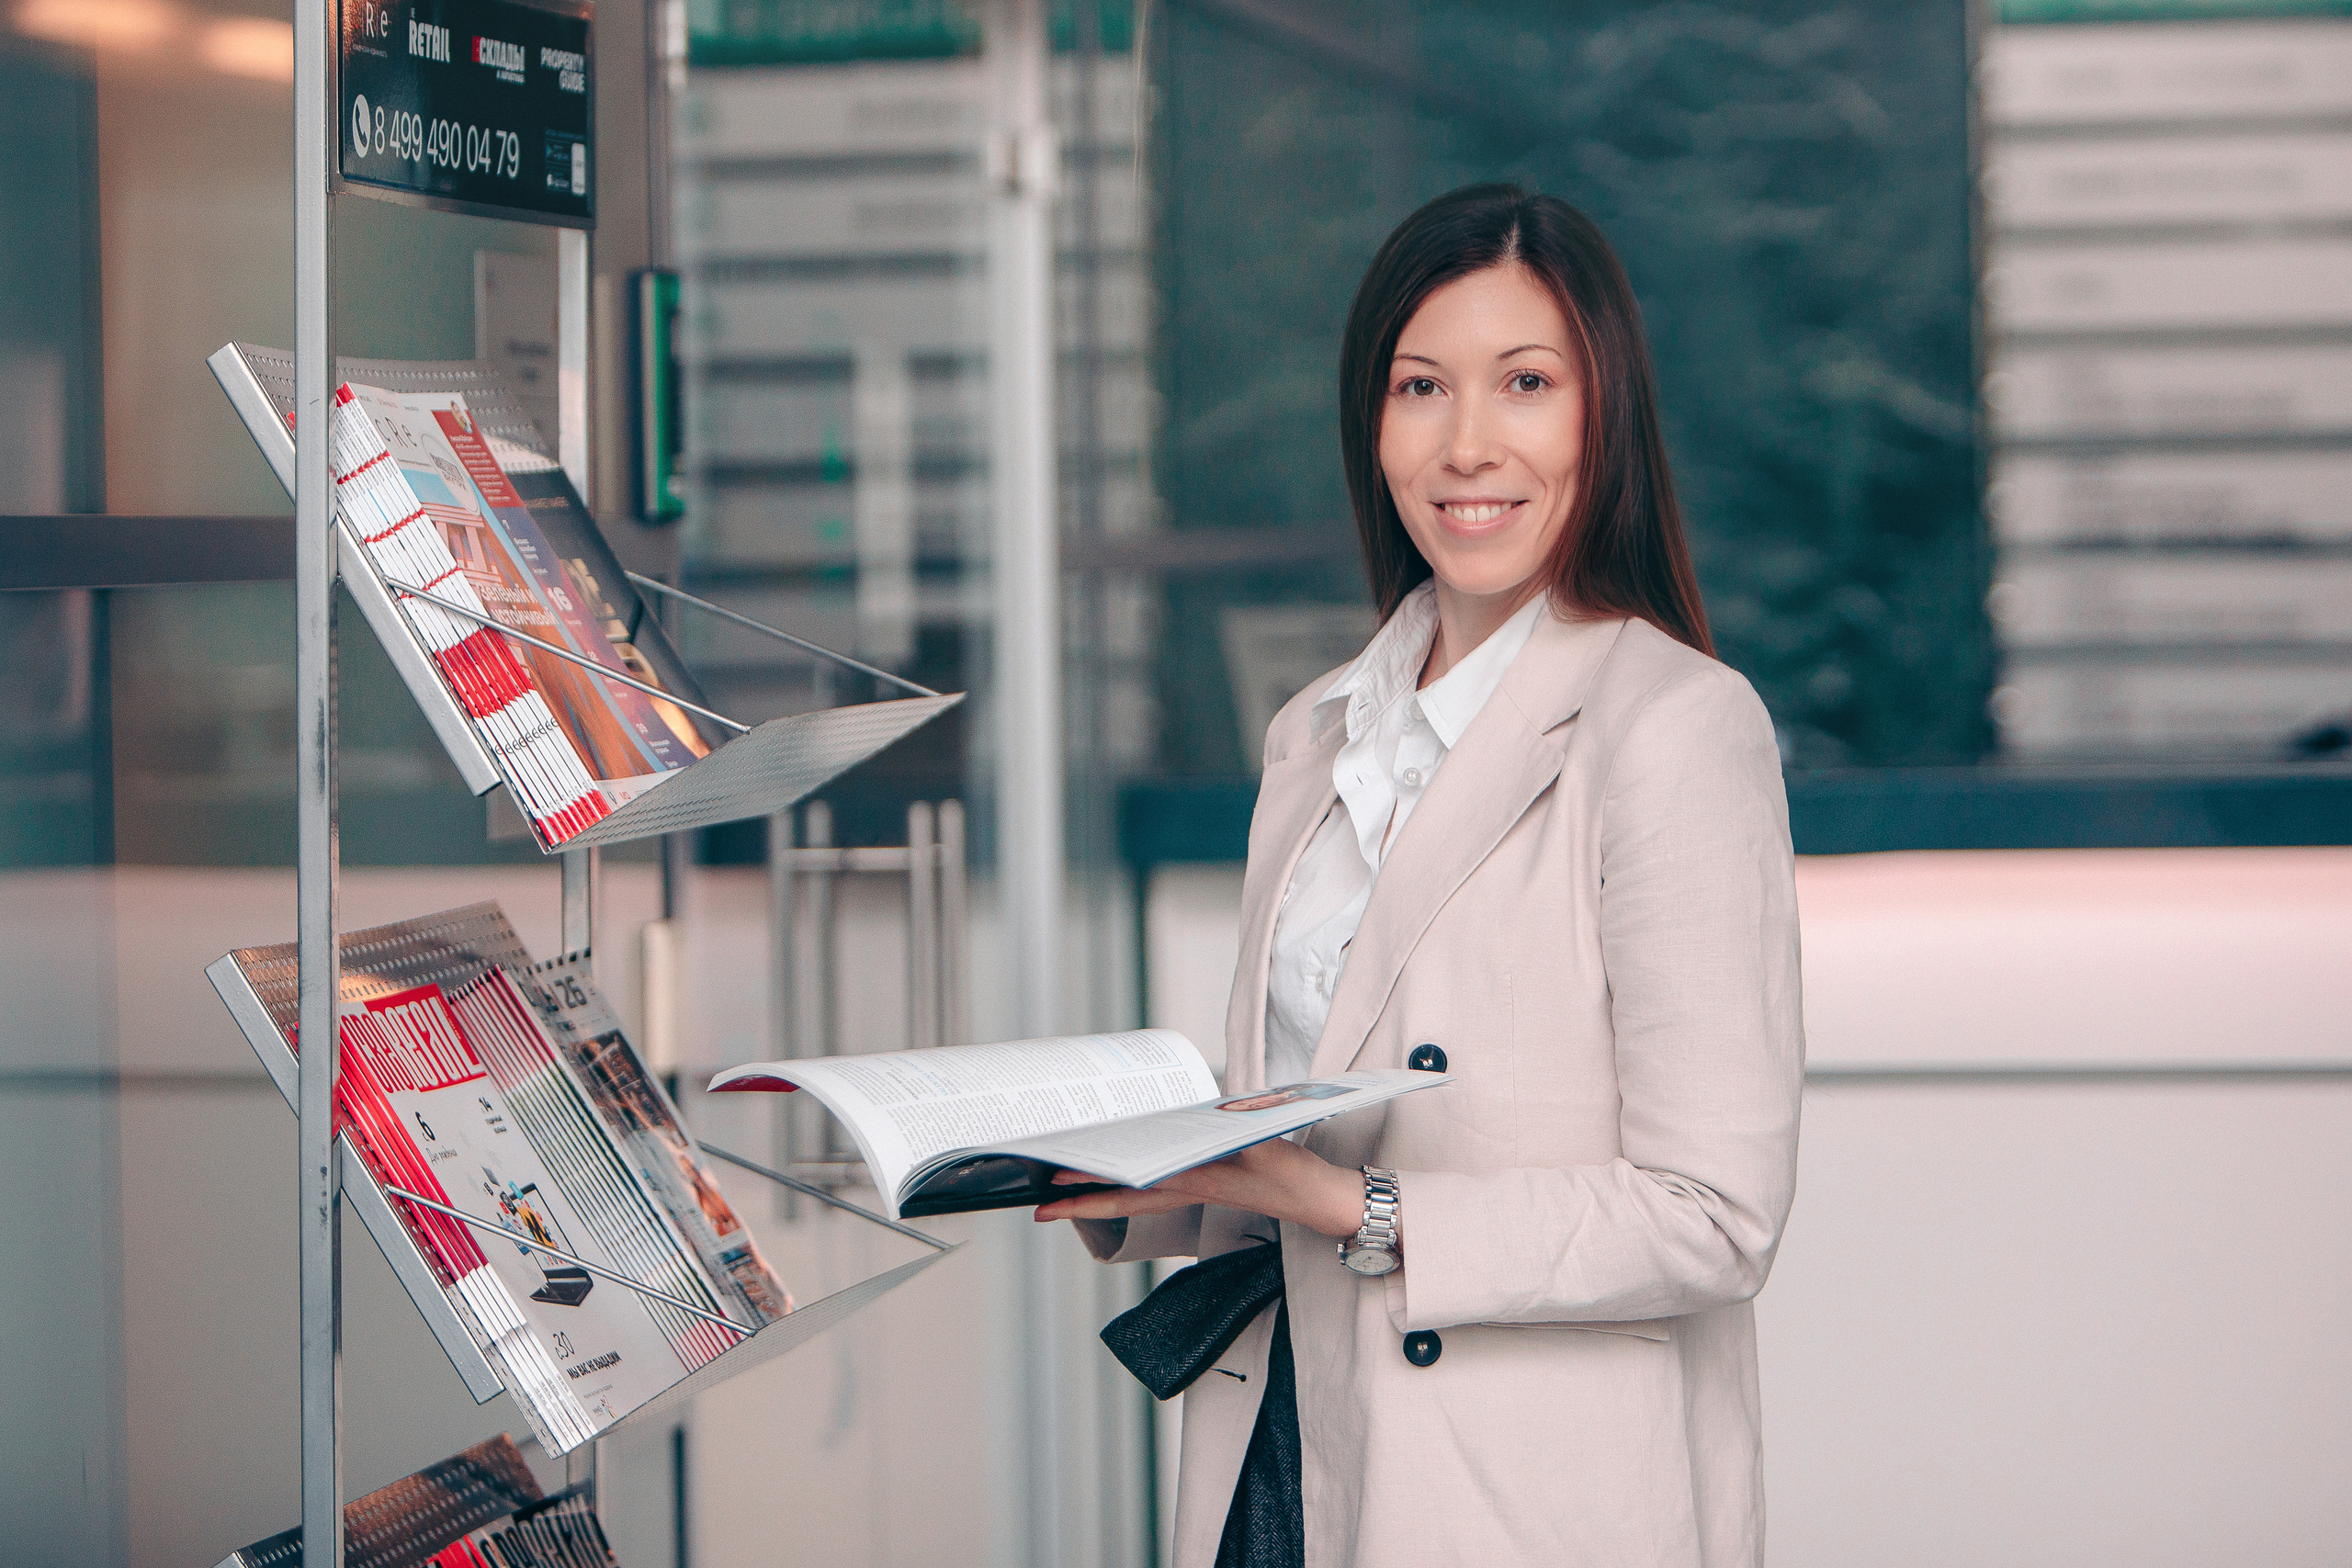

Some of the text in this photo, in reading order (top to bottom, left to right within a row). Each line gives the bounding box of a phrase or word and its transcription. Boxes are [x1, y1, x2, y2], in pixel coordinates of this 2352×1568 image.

[409, 19, 450, 62] RETAIL
[375, 106, 385, 154] 8
[390, 110, 422, 162] 499
[427, 118, 461, 168] 490
[467, 125, 491, 174] 04
[496, 130, 520, 179] 79
[548, 586, 573, 611] 16
